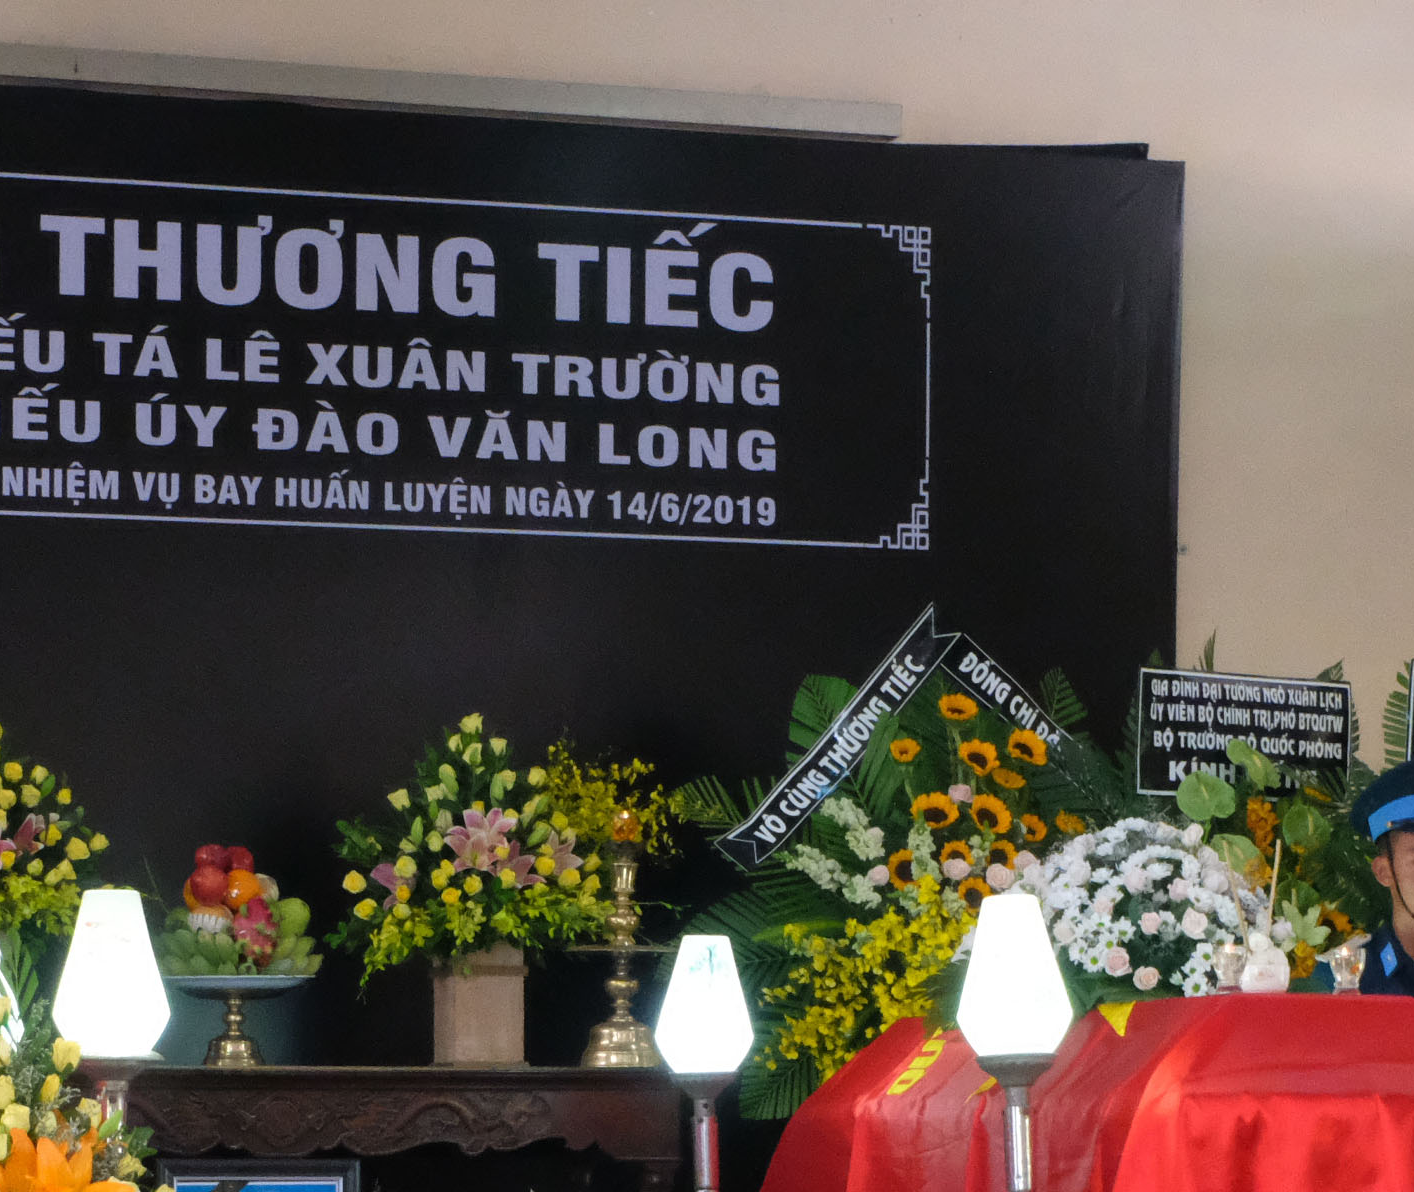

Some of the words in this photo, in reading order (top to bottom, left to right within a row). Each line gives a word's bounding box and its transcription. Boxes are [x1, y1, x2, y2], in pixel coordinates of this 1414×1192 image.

[40, 215, 496, 318] THƯƠNG
[538, 222, 775, 332] TIẾC
[93, 325, 178, 378] TÁ
[206, 330, 280, 382] LÊ
[306, 338, 486, 392] XUÂN
[512, 350, 780, 406] TRƯỜNG
[136, 393, 227, 448] ÚY
[252, 400, 398, 456] ĐÀO
[428, 410, 566, 462] VĂN
[599, 424, 777, 472] LONG
[2, 461, 119, 506] NHIỆM
[133, 472, 180, 510] VỤ
[195, 474, 262, 506] BAY
[275, 469, 370, 510] HUẤN
[385, 477, 491, 521] LUYỆN
[506, 482, 594, 519] NGÀY
[607, 490, 776, 527] 14/6/2019
[958, 651, 1012, 705] ĐỒNG
[1010, 695, 1040, 729] CHÍ
[1150, 697, 1163, 722] ỦY
[1167, 700, 1195, 722] VIÊN
[1198, 703, 1214, 728] BỘ
[1217, 702, 1251, 727] CHÍNH
[1151, 679, 1168, 697] GIA
[1172, 677, 1199, 699] ĐÌNH
[1202, 682, 1222, 704] ĐẠI
[1225, 681, 1260, 703] TƯỚNG
[1263, 685, 1286, 705] NGÔ
[1288, 687, 1317, 708] XUÂN
[1320, 692, 1343, 712] LỊCH
[753, 813, 787, 844] VÔ
[779, 769, 830, 817] CÙNG
[818, 695, 892, 774] THƯƠNG
[880, 654, 925, 700] TIẾC
[1154, 727, 1174, 752] BỘ
[1261, 732, 1296, 755] QUỐC
[1298, 736, 1343, 760] PHÒNG
